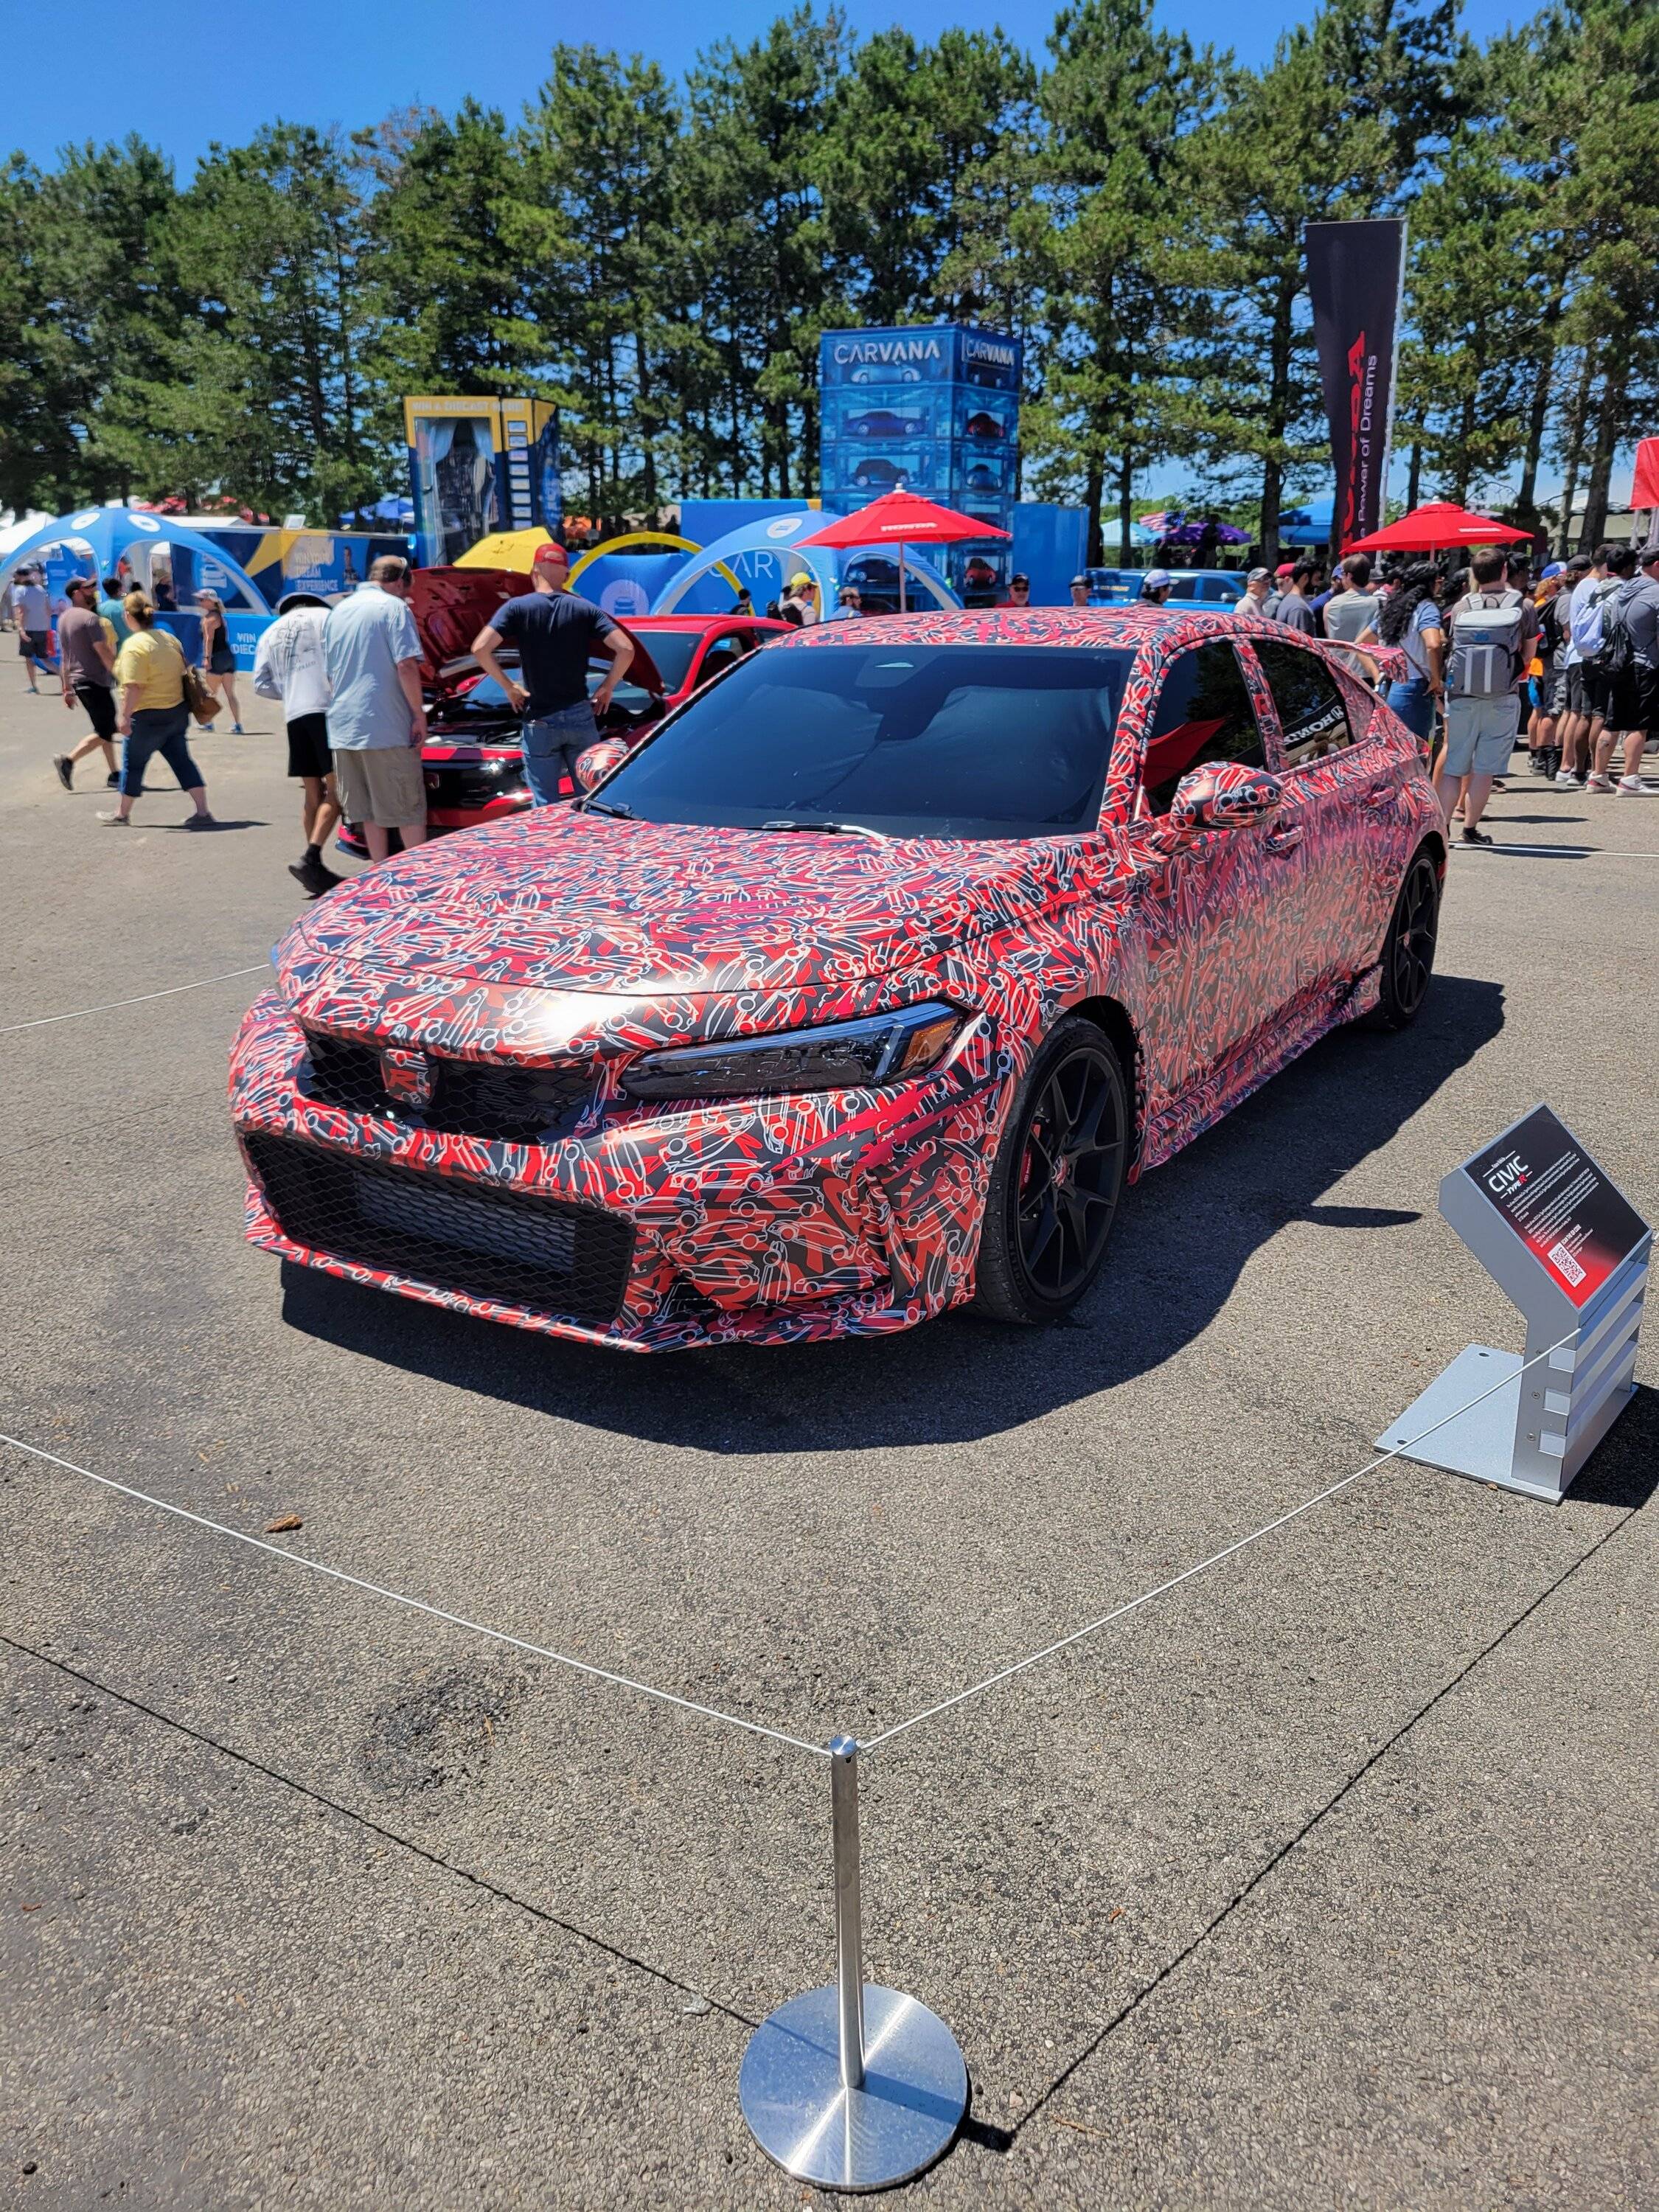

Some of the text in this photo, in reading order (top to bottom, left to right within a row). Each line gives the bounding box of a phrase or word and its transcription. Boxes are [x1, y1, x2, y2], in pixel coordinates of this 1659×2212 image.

[834, 338, 941, 365] CARVANA
[966, 338, 1015, 366] CARVANA
[1360, 354, 1379, 432] Dreams
[1360, 437, 1370, 458] of
[236, 632, 257, 643] WIN
[1488, 1155, 1529, 1193] CIVIC
